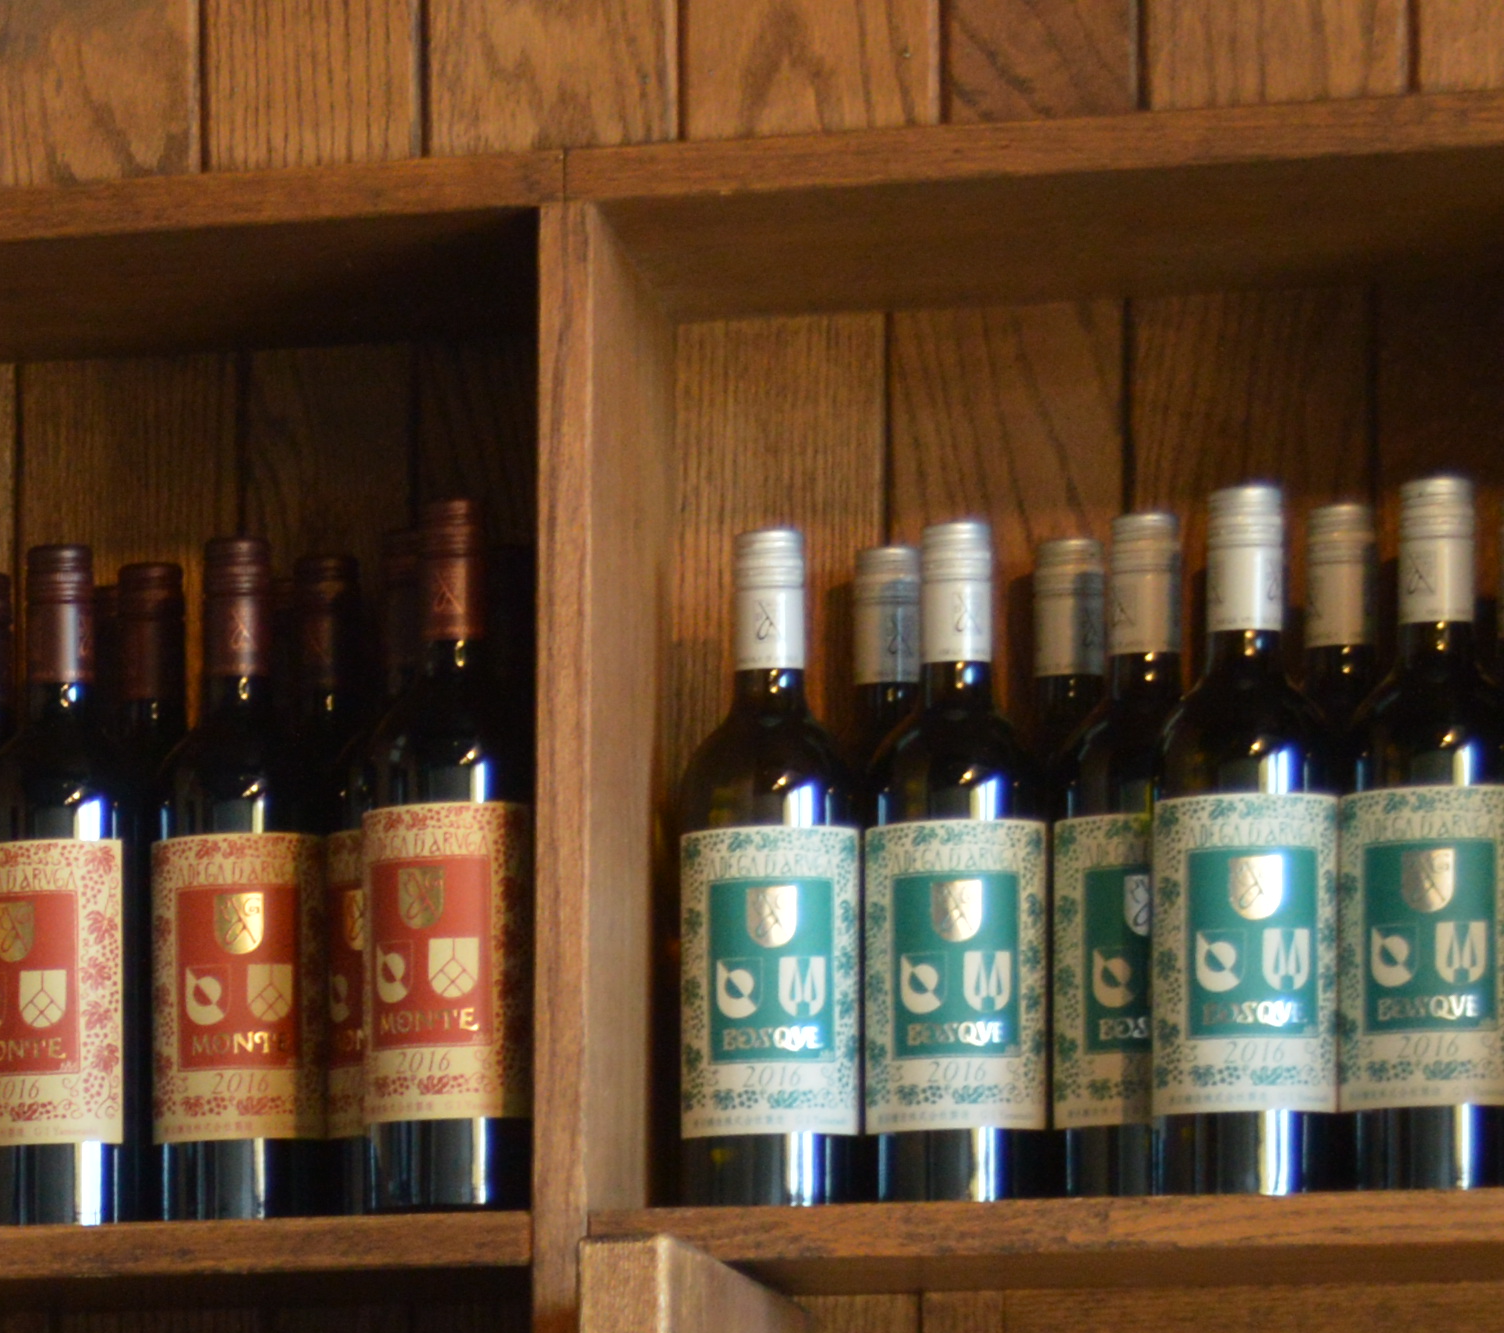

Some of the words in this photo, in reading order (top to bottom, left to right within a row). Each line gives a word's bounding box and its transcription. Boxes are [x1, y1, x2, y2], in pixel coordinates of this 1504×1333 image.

[1202, 1000, 1308, 1028] BOSQVE
[1377, 994, 1482, 1022] BOSQVE
[380, 1007, 480, 1035] MONTE
[1097, 1016, 1147, 1040] BOS
[192, 1031, 288, 1056] MONTE
[722, 1025, 825, 1052] BOSQVE
[906, 1021, 1005, 1047] BOSQVE
[1224, 1041, 1286, 1064] 2016
[1398, 1035, 1460, 1060] 2016
[395, 1051, 452, 1074] 2016
[927, 1060, 987, 1085] 2016
[212, 1072, 271, 1096] 2016
[743, 1065, 803, 1089] 2016
